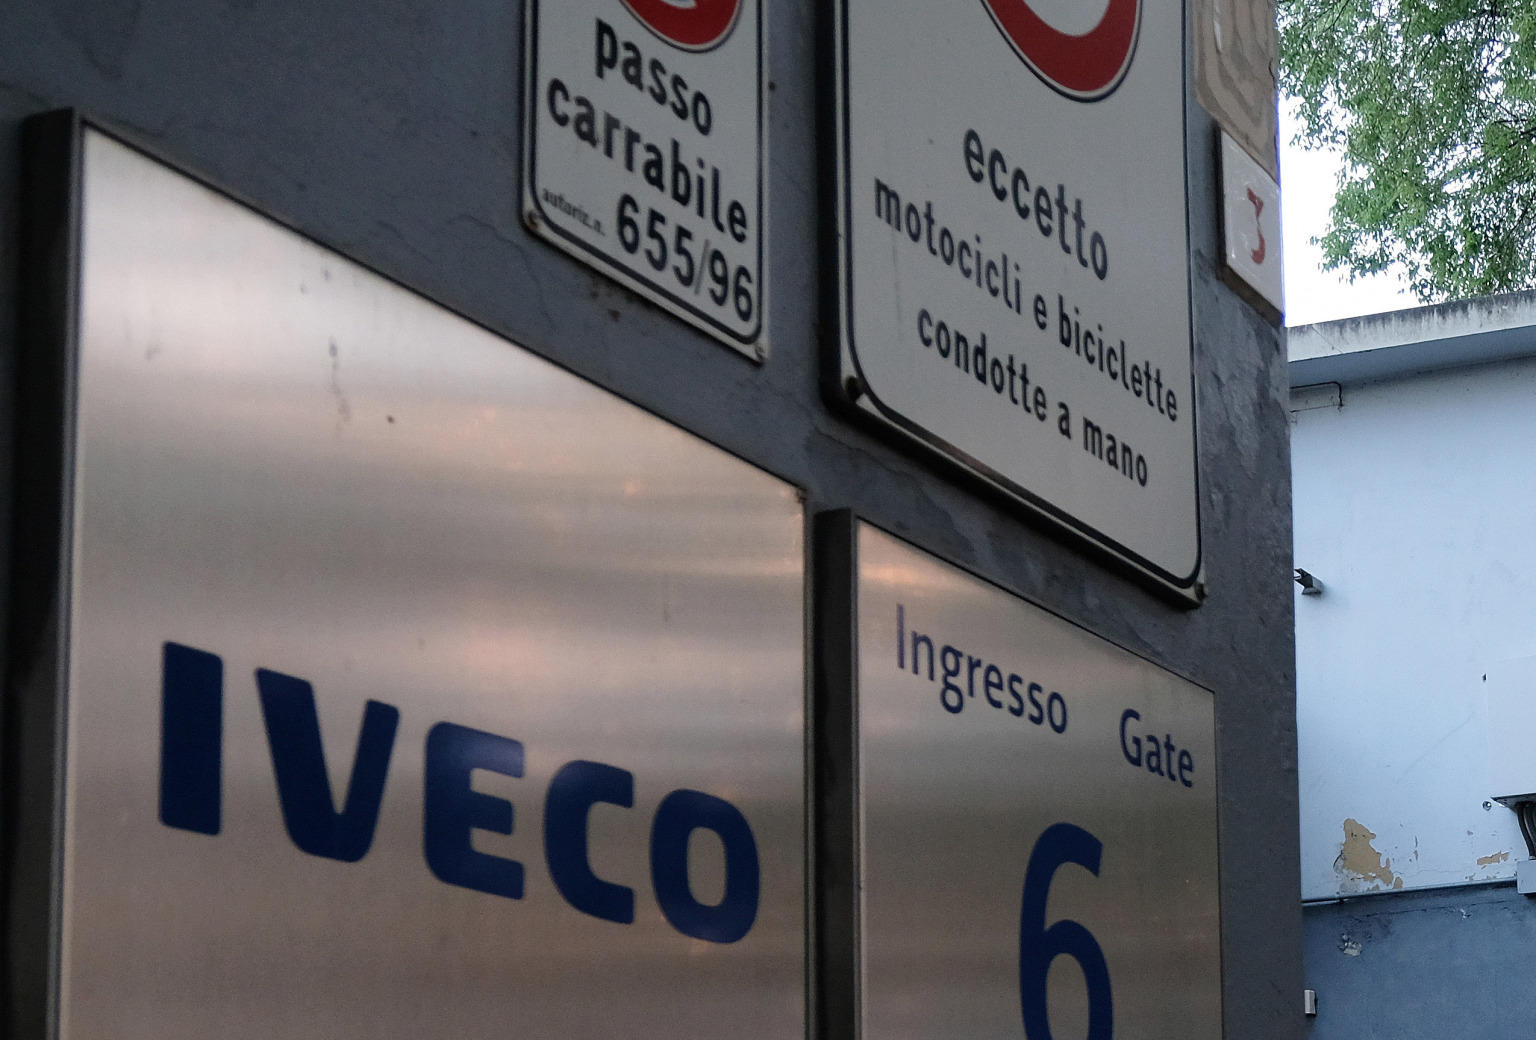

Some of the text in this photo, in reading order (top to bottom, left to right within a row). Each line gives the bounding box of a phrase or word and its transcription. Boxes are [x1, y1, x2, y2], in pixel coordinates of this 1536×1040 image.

[547, 78, 748, 243] carrabile
[595, 17, 712, 136] passo
[617, 194, 753, 322] 655/96
[963, 129, 1108, 281] eccetto
[875, 176, 1178, 422] motocicli e biciclette
[917, 308, 1148, 487] condotte a mano
[897, 603, 1195, 788] Ingresso Gate
[159, 640, 761, 945] IVECO
